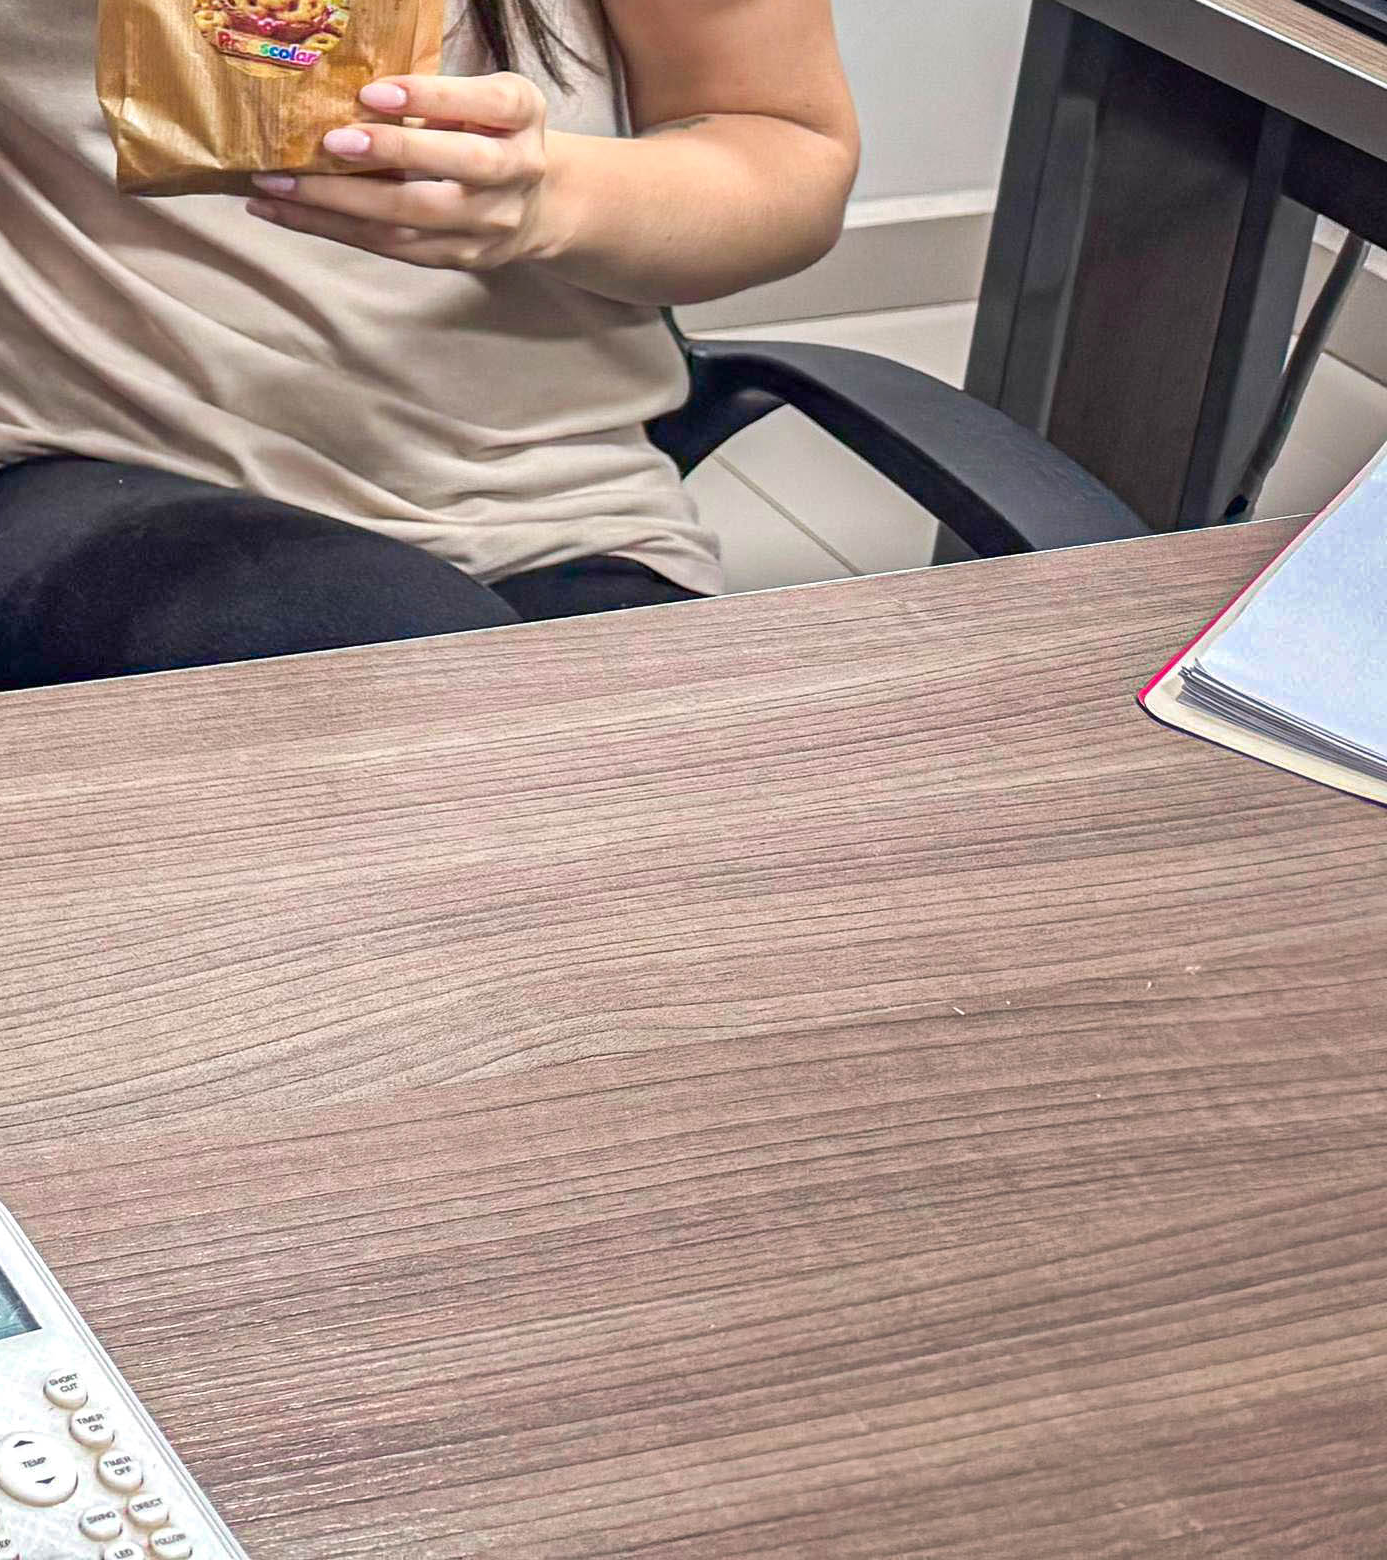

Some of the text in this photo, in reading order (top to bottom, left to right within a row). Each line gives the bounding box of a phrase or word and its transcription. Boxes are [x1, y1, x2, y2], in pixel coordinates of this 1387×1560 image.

[217, 30, 319, 64] Prscolar
[49, 1373, 78, 1387] SHORT
[60, 1382, 79, 1393] CUT
[77, 1413, 104, 1426] TIMER
[89, 1424, 103, 1433] ON
[22, 1456, 47, 1469] TEMP
[103, 1456, 131, 1470] TIMER
[115, 1466, 132, 1476] OFF
[132, 1498, 163, 1514] DIRECT
[86, 1510, 116, 1525] SWING
